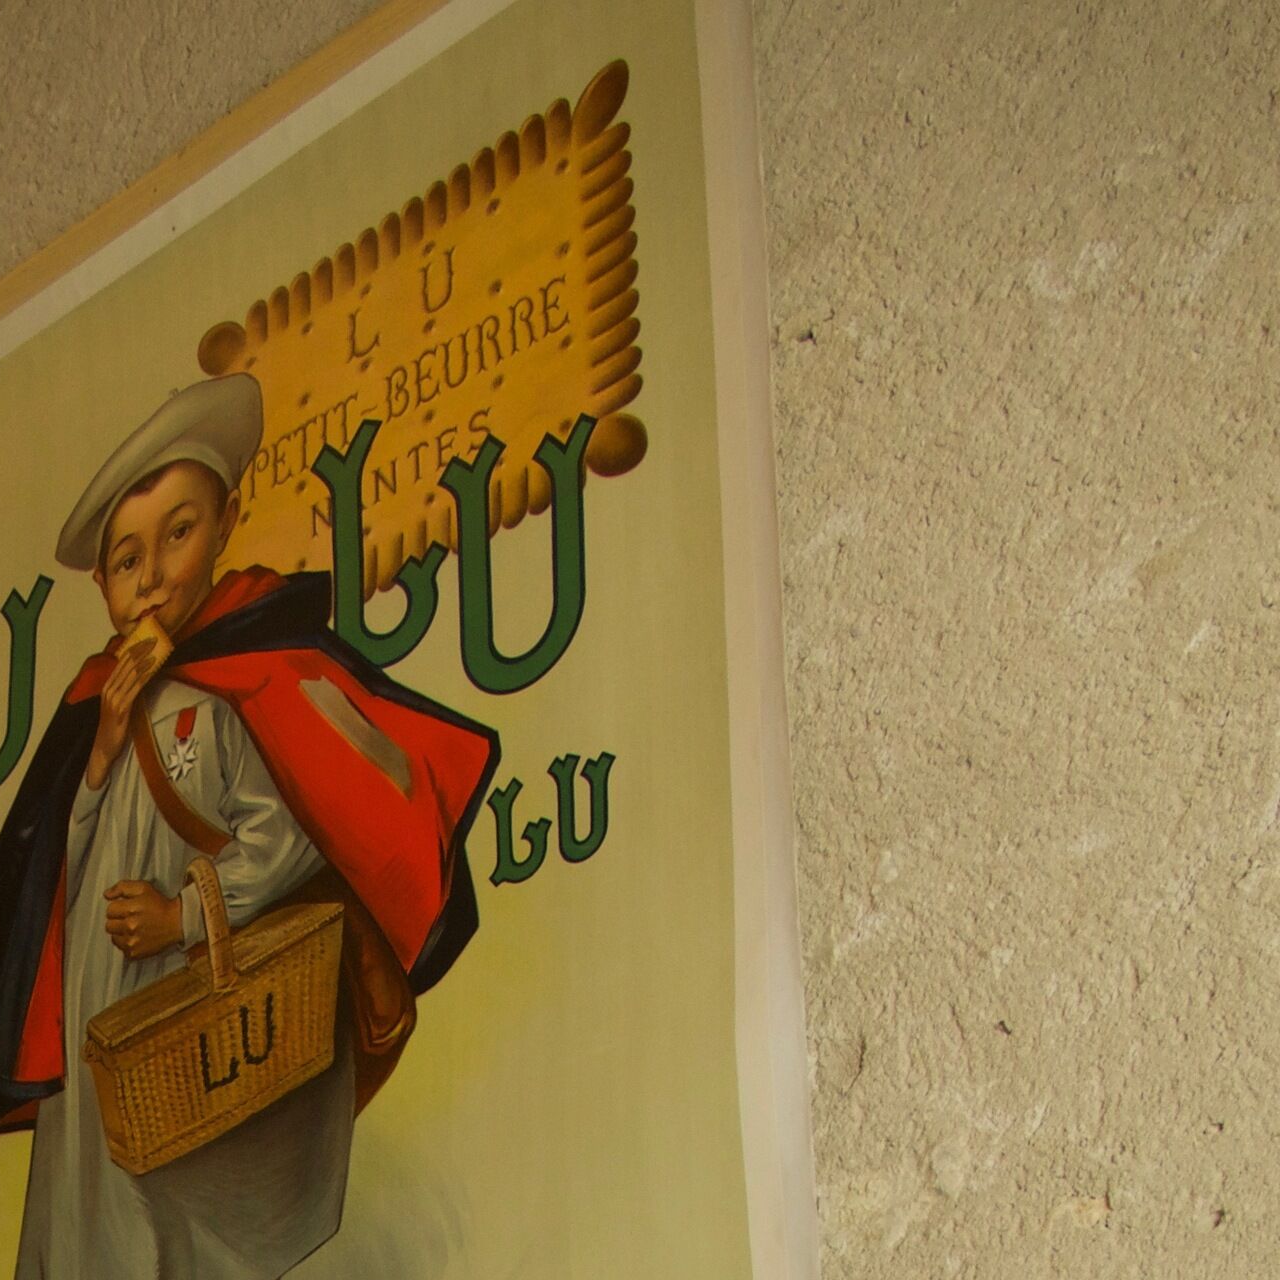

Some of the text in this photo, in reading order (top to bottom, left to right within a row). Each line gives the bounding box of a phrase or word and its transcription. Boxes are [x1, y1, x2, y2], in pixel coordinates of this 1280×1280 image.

[312, 407, 491, 537] NNTES
[311, 414, 598, 696] LU
[487, 752, 616, 887] LU
[199, 992, 276, 1094] LU
